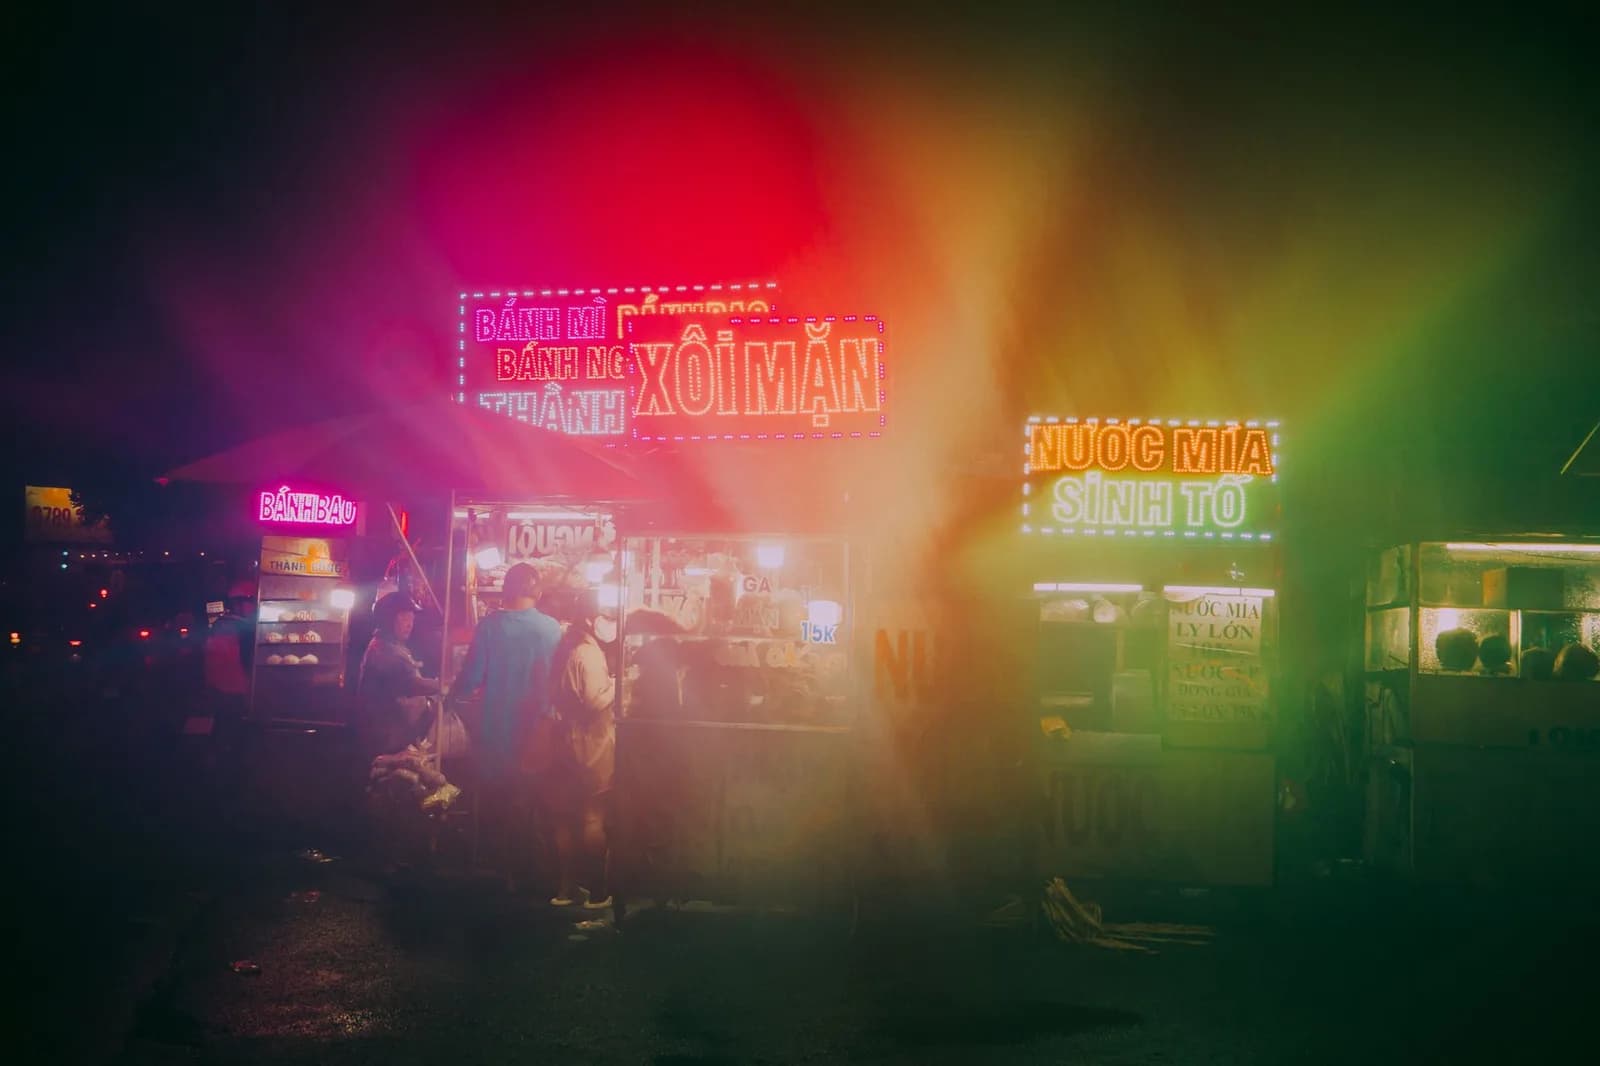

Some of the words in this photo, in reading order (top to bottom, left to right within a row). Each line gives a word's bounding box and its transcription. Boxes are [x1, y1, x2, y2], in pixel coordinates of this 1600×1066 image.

[476, 296, 560, 341] BÁNH
[568, 296, 607, 339] MÌ
[497, 341, 579, 380] BÁNH
[631, 324, 737, 416] XÔI
[744, 323, 881, 427] MẶN
[1173, 424, 1273, 474] MÍA
[1180, 473, 1254, 527] TỐ
[1176, 622, 1202, 638] LY
[1208, 620, 1254, 640] LỚN
[1227, 598, 1260, 620] MÍA
